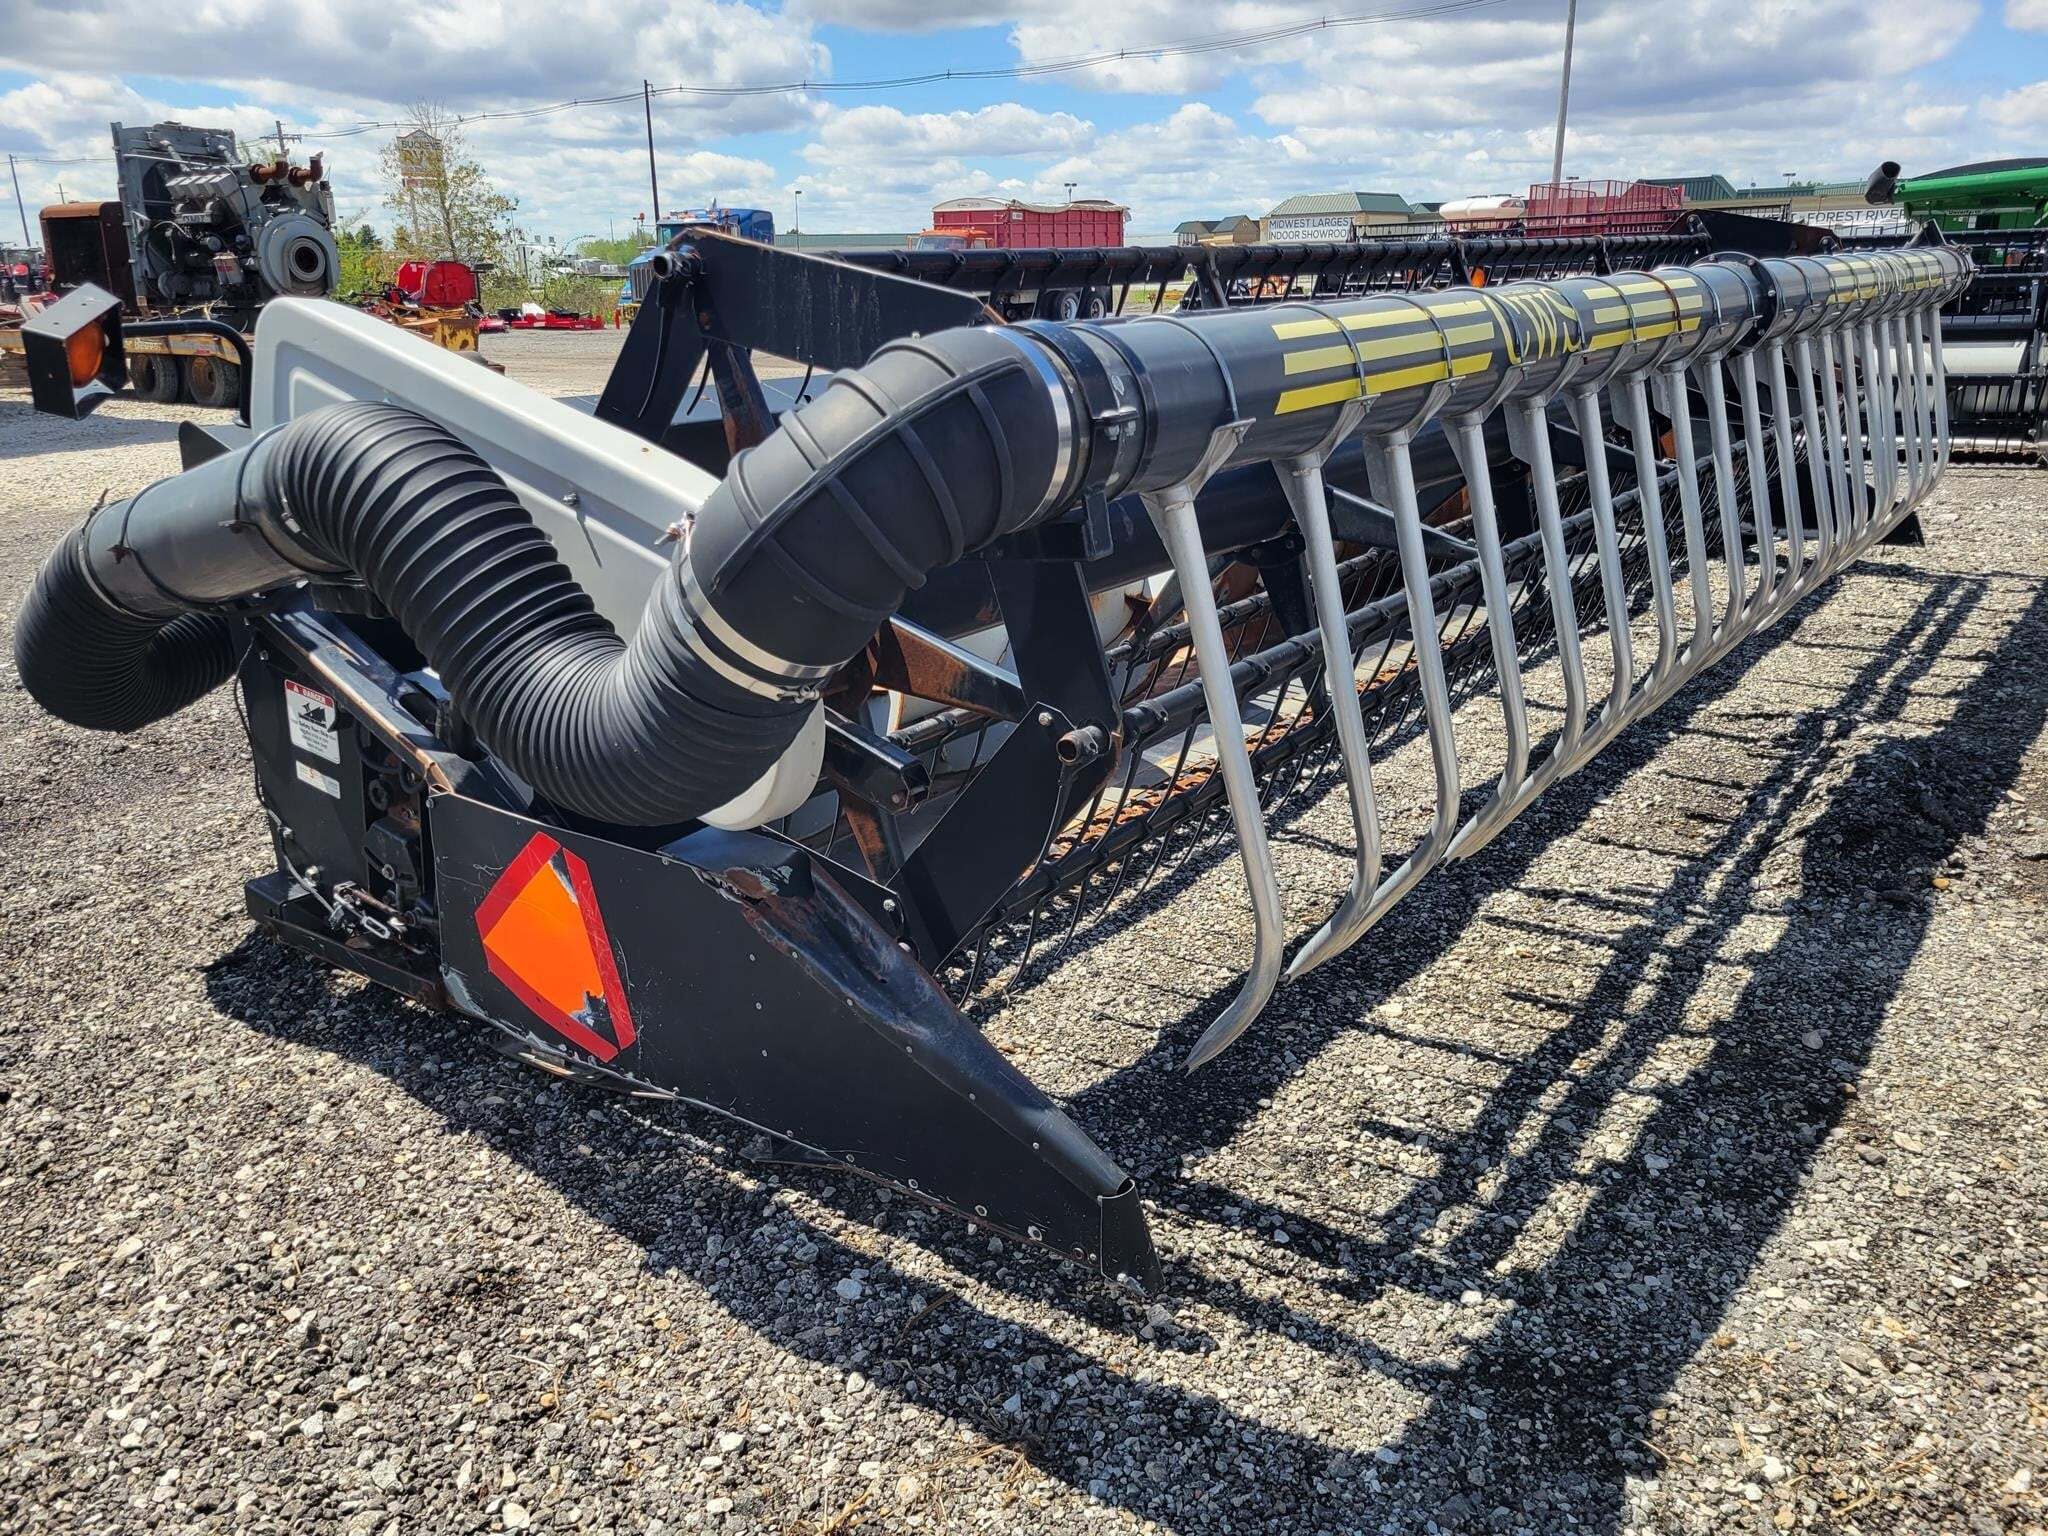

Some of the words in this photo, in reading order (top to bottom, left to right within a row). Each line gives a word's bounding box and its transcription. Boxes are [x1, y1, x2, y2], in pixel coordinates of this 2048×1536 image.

[1807, 211, 1863, 223] FOREST
[1269, 218, 1311, 229] MIDWEST
[1268, 230, 1300, 240] INDOOR
[1302, 228, 1348, 239] SHOWROO
